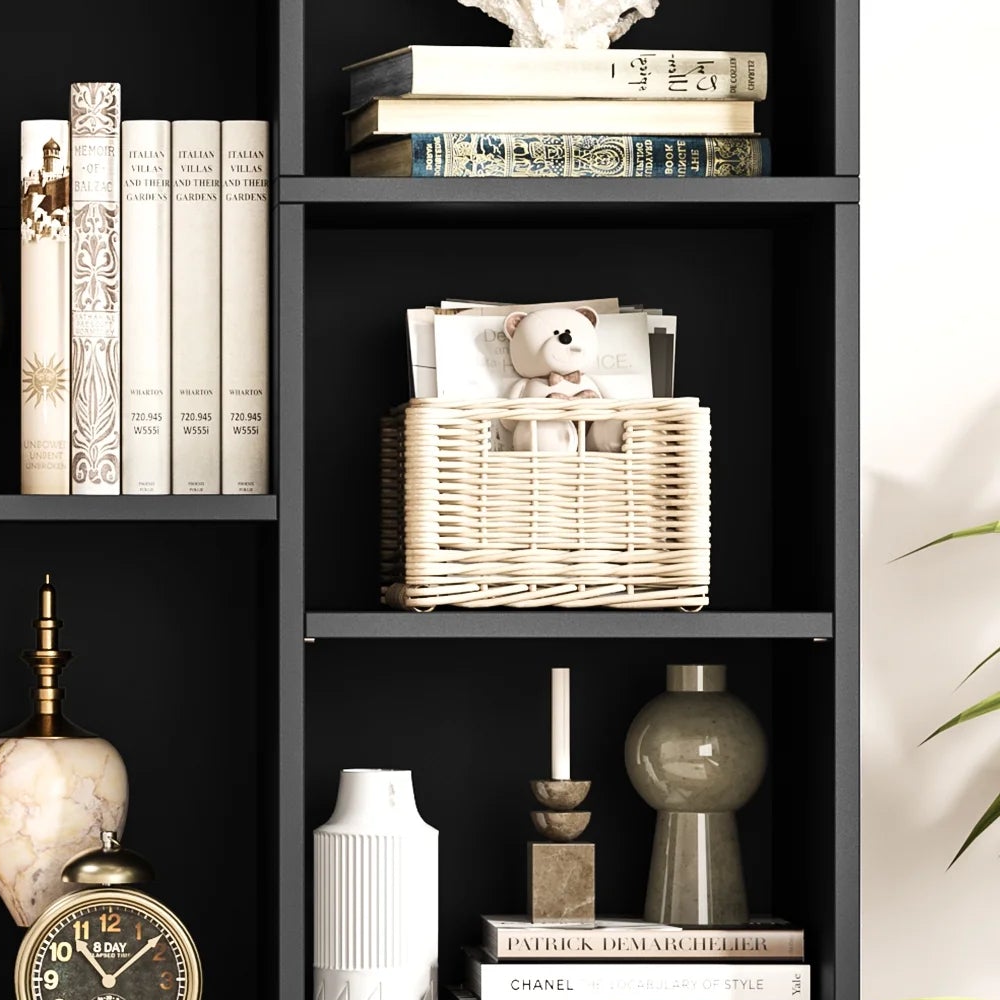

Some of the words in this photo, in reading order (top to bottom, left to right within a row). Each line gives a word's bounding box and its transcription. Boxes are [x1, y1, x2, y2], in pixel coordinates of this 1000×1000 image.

[74, 145, 115, 157] MEMOIR
[129, 150, 165, 159] ITALIAN
[178, 150, 215, 159] ITALIAN
[228, 150, 264, 159] ITALIAN
[131, 165, 163, 173] VILLAS
[181, 165, 213, 173] VILLAS
[231, 165, 262, 173] VILLAS
[144, 179, 170, 187] THEIR
[194, 179, 220, 187] THEIR
[244, 179, 269, 187] THEIR
[126, 193, 168, 201] GARDENS
[176, 193, 217, 201] GARDENS
[225, 193, 267, 201] GARDENS
[131, 412, 163, 422] 720.945
[180, 412, 212, 422] 720.945
[230, 412, 262, 422] 720.945
[99, 913, 121, 933] 12
[73, 920, 89, 940] 11
[135, 922, 142, 940] 1
[93, 941, 101, 953] 8
[103, 942, 128, 953] DAY
[508, 937, 593, 951] PATRICK
[603, 937, 768, 951] DEMARCHELIER
[50, 941, 73, 962] 10
[153, 942, 167, 962] 2
[43, 970, 59, 990] 9
[160, 971, 173, 990] 3
[510, 979, 574, 991] CHANEL
[702, 979, 721, 991] OF
[724, 979, 764, 991] STYLE
[792, 973, 802, 996] Yale
